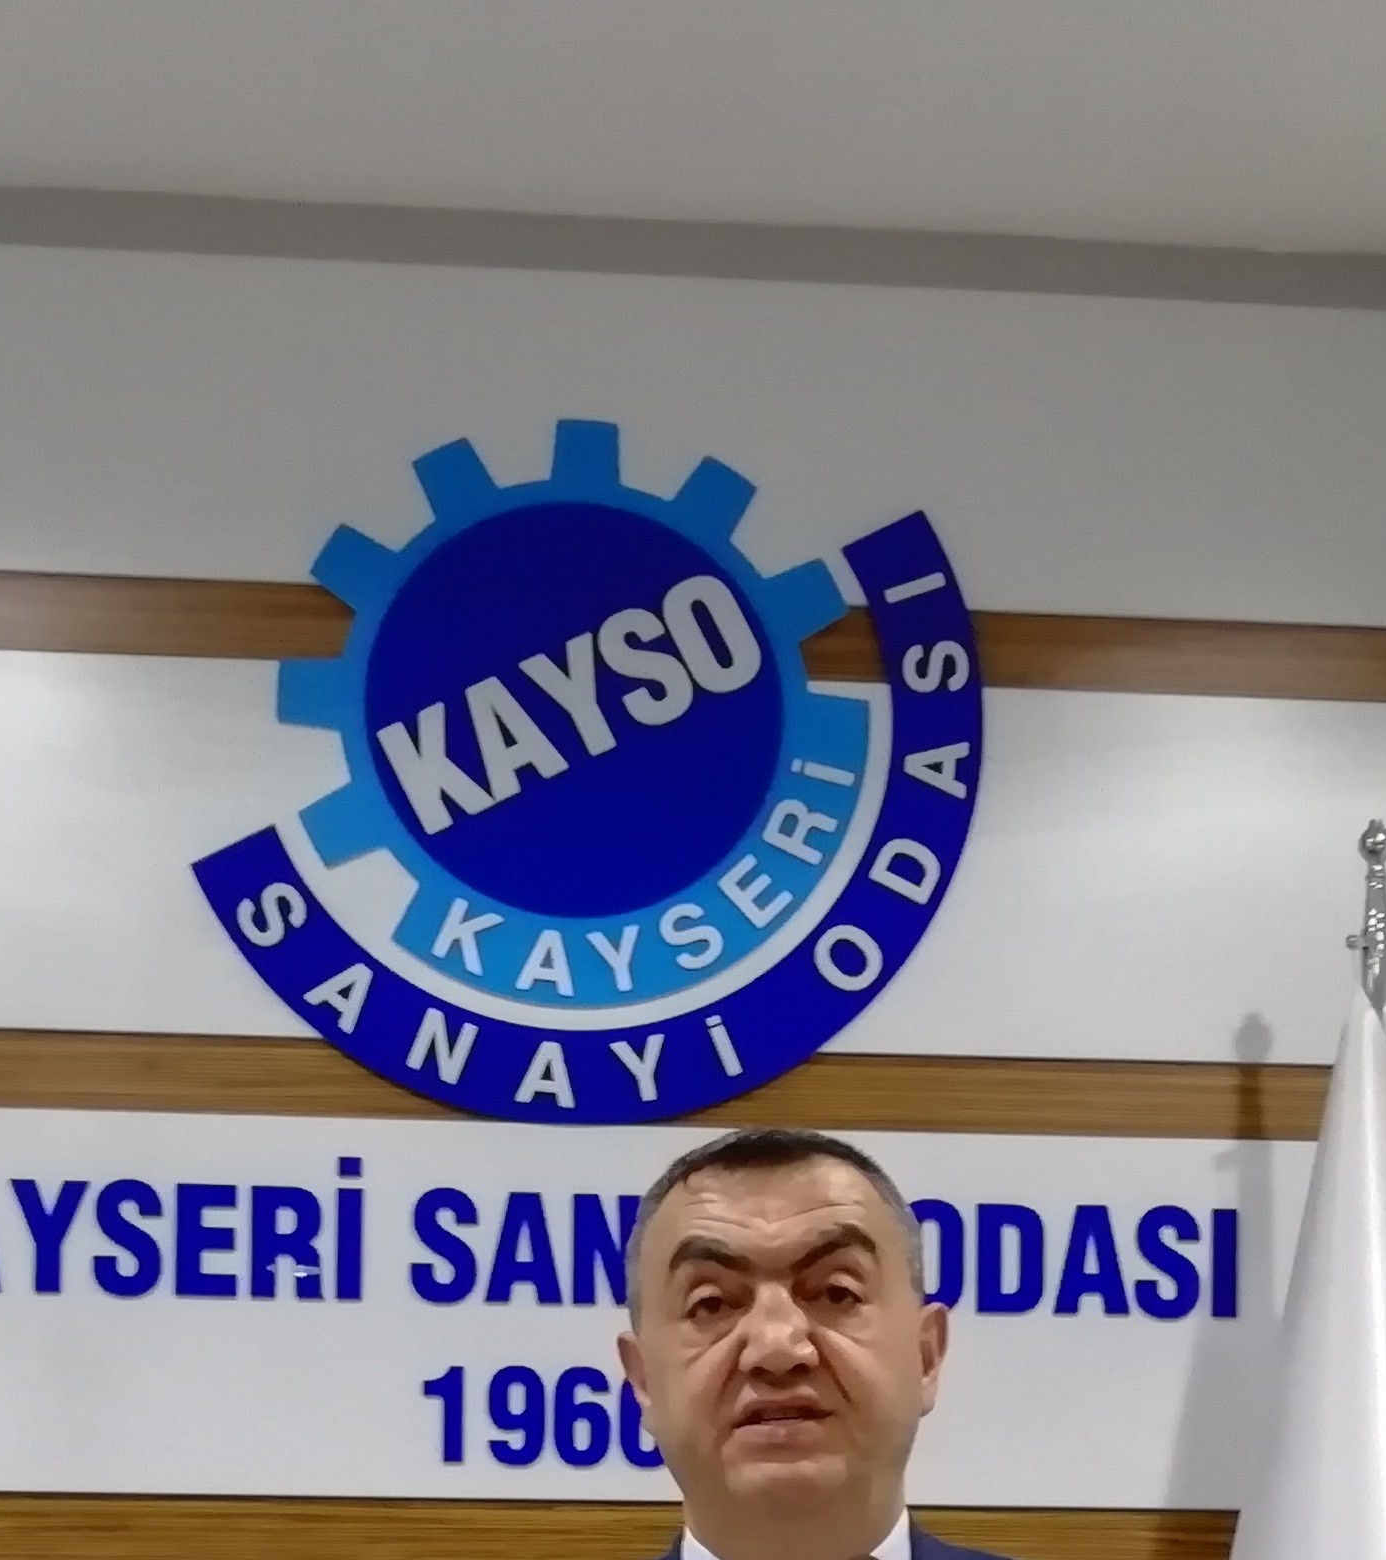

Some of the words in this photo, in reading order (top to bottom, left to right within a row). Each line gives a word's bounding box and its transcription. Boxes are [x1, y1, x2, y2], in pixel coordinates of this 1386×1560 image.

[377, 573, 763, 836] KAYSO
[236, 881, 744, 1108] SANAYİ
[815, 572, 970, 991] ODASI
[432, 758, 856, 997] KAYSERİ
[410, 1187, 643, 1306] SAN
